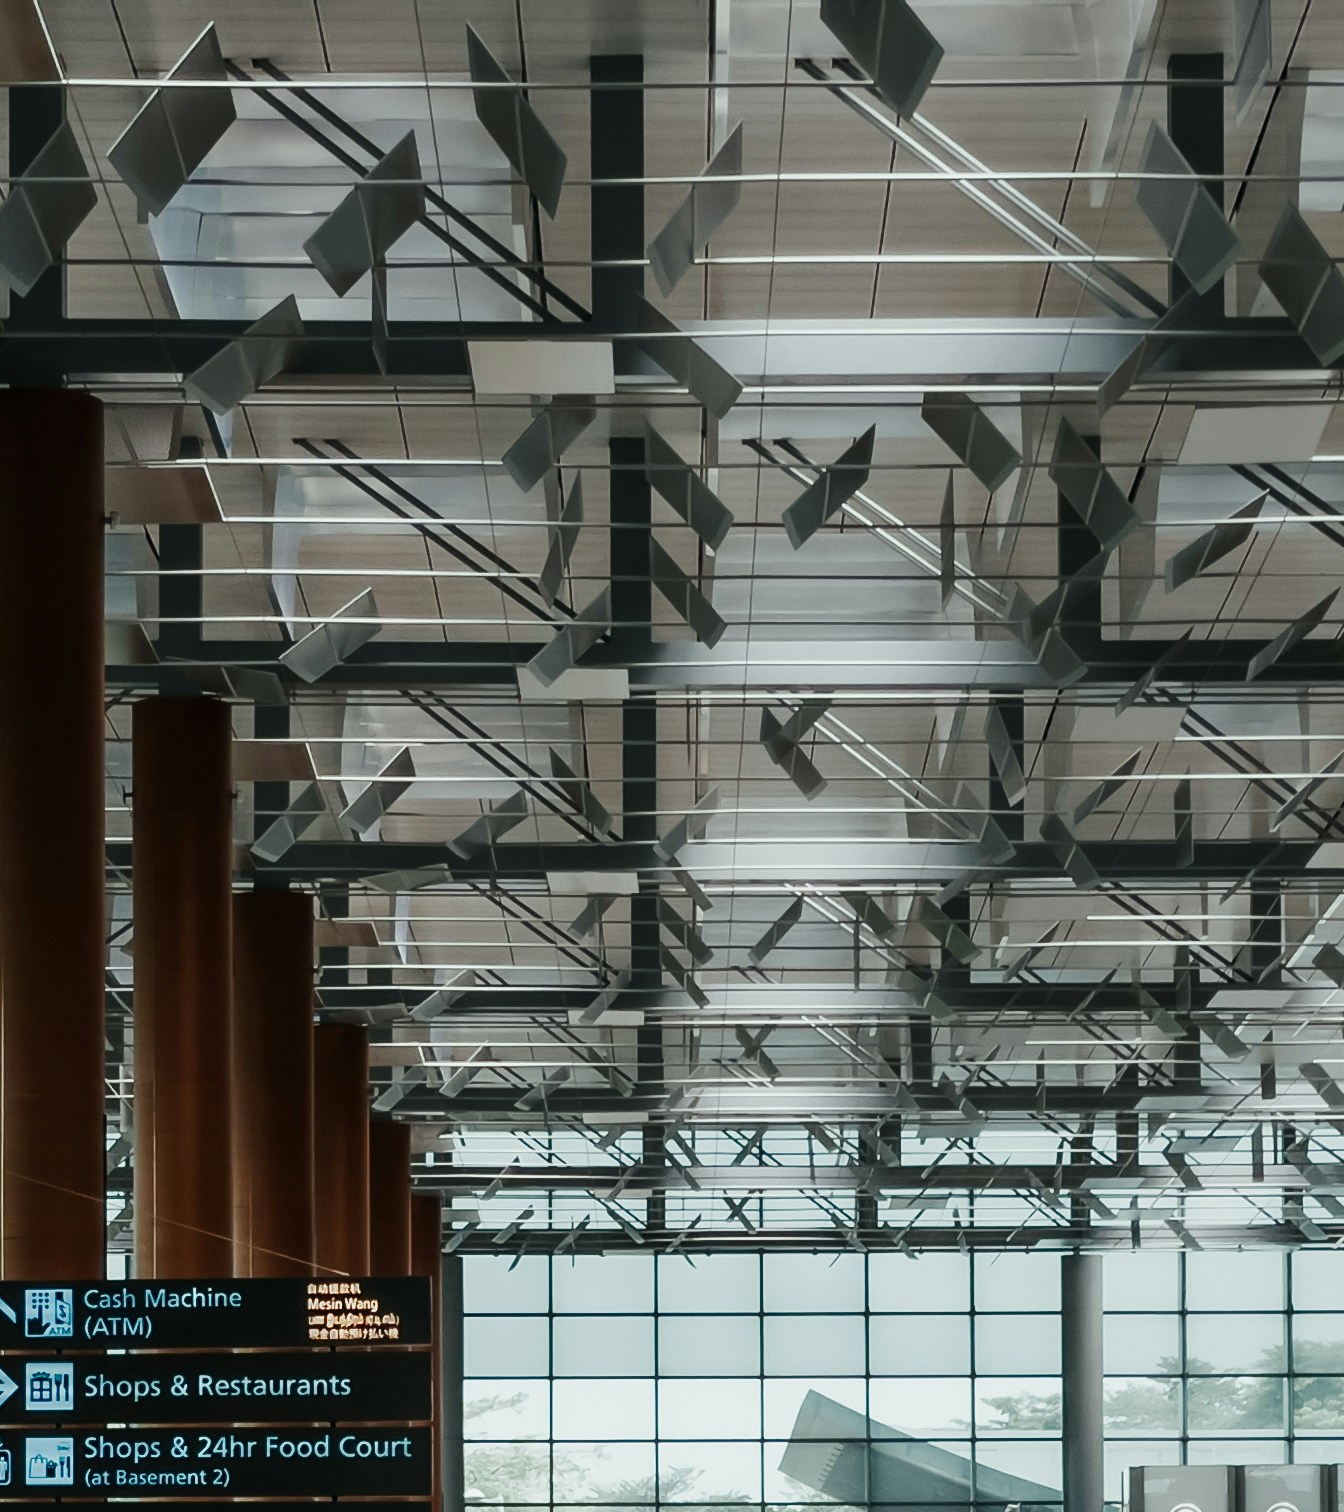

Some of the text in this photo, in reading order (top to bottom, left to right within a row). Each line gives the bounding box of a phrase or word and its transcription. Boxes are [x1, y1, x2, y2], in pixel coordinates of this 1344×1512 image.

[84, 1287, 242, 1309] Cash Machine
[307, 1297, 379, 1313] Mesin Wang
[49, 1327, 71, 1336] ATM
[84, 1316, 152, 1339] (ATM)
[84, 1373, 351, 1402] Shops & Restaurants
[84, 1435, 412, 1464] Shops & 24hr Food Court
[84, 1468, 230, 1488] (at Basement 2)
